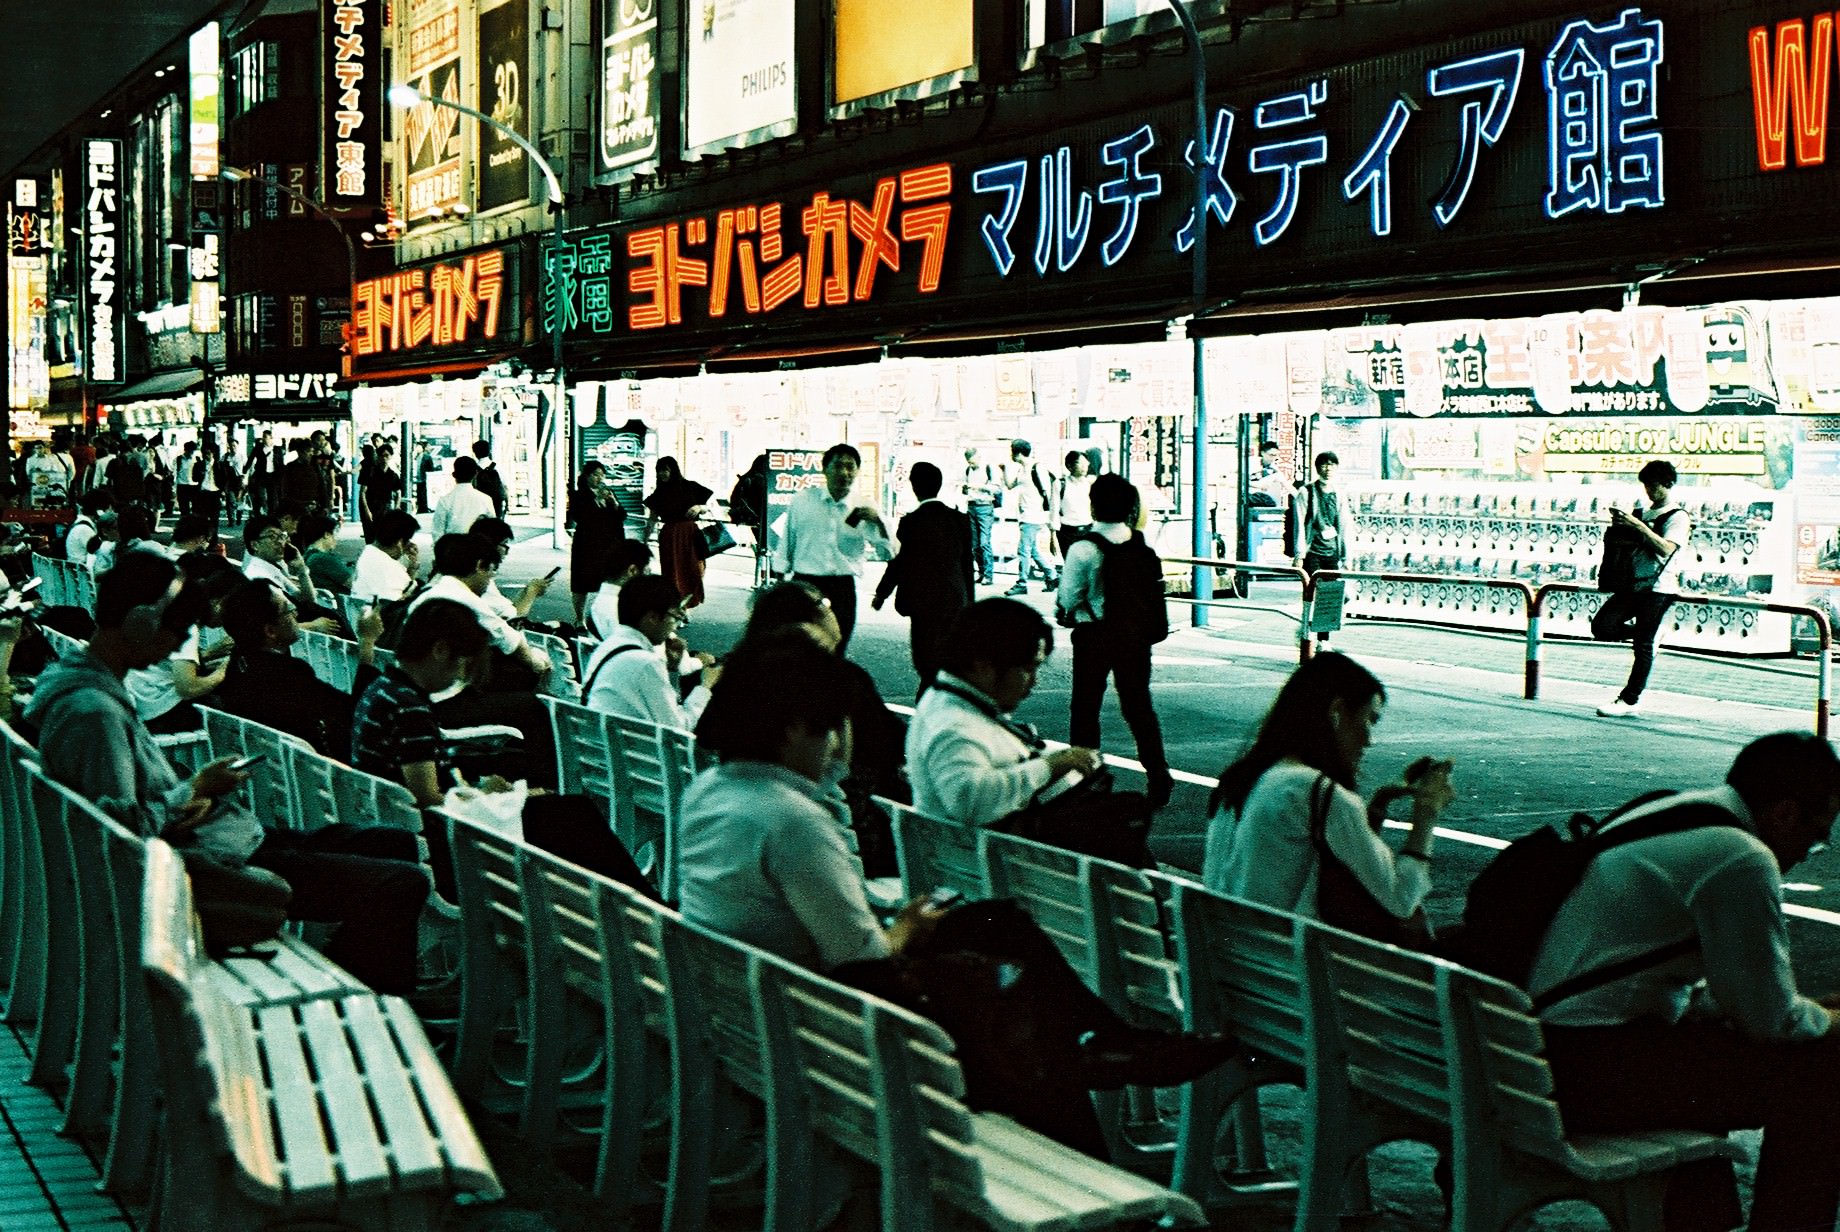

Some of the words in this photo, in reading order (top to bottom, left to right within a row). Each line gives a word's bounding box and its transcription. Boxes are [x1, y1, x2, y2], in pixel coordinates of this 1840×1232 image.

[334, 0, 365, 196] チメディア東館
[495, 60, 519, 119] 3D
[741, 61, 787, 98] PHILIPS
[1748, 10, 1840, 174] W
[971, 7, 1666, 278] マルチメディア館
[88, 140, 117, 303] ヨドバシカメラ
[290, 166, 305, 215] アコム
[544, 233, 613, 333] 家電
[626, 162, 953, 330] ヨドバシカメラ
[354, 250, 505, 356] ヨドバシカメラ
[1486, 309, 1668, 387] 全案内
[769, 451, 823, 472] ヨドバ
[775, 472, 828, 491] カメラ
[1544, 423, 1622, 453] Capsule
[1623, 422, 1668, 453] Toy
[1669, 421, 1765, 453] JUNGLE
